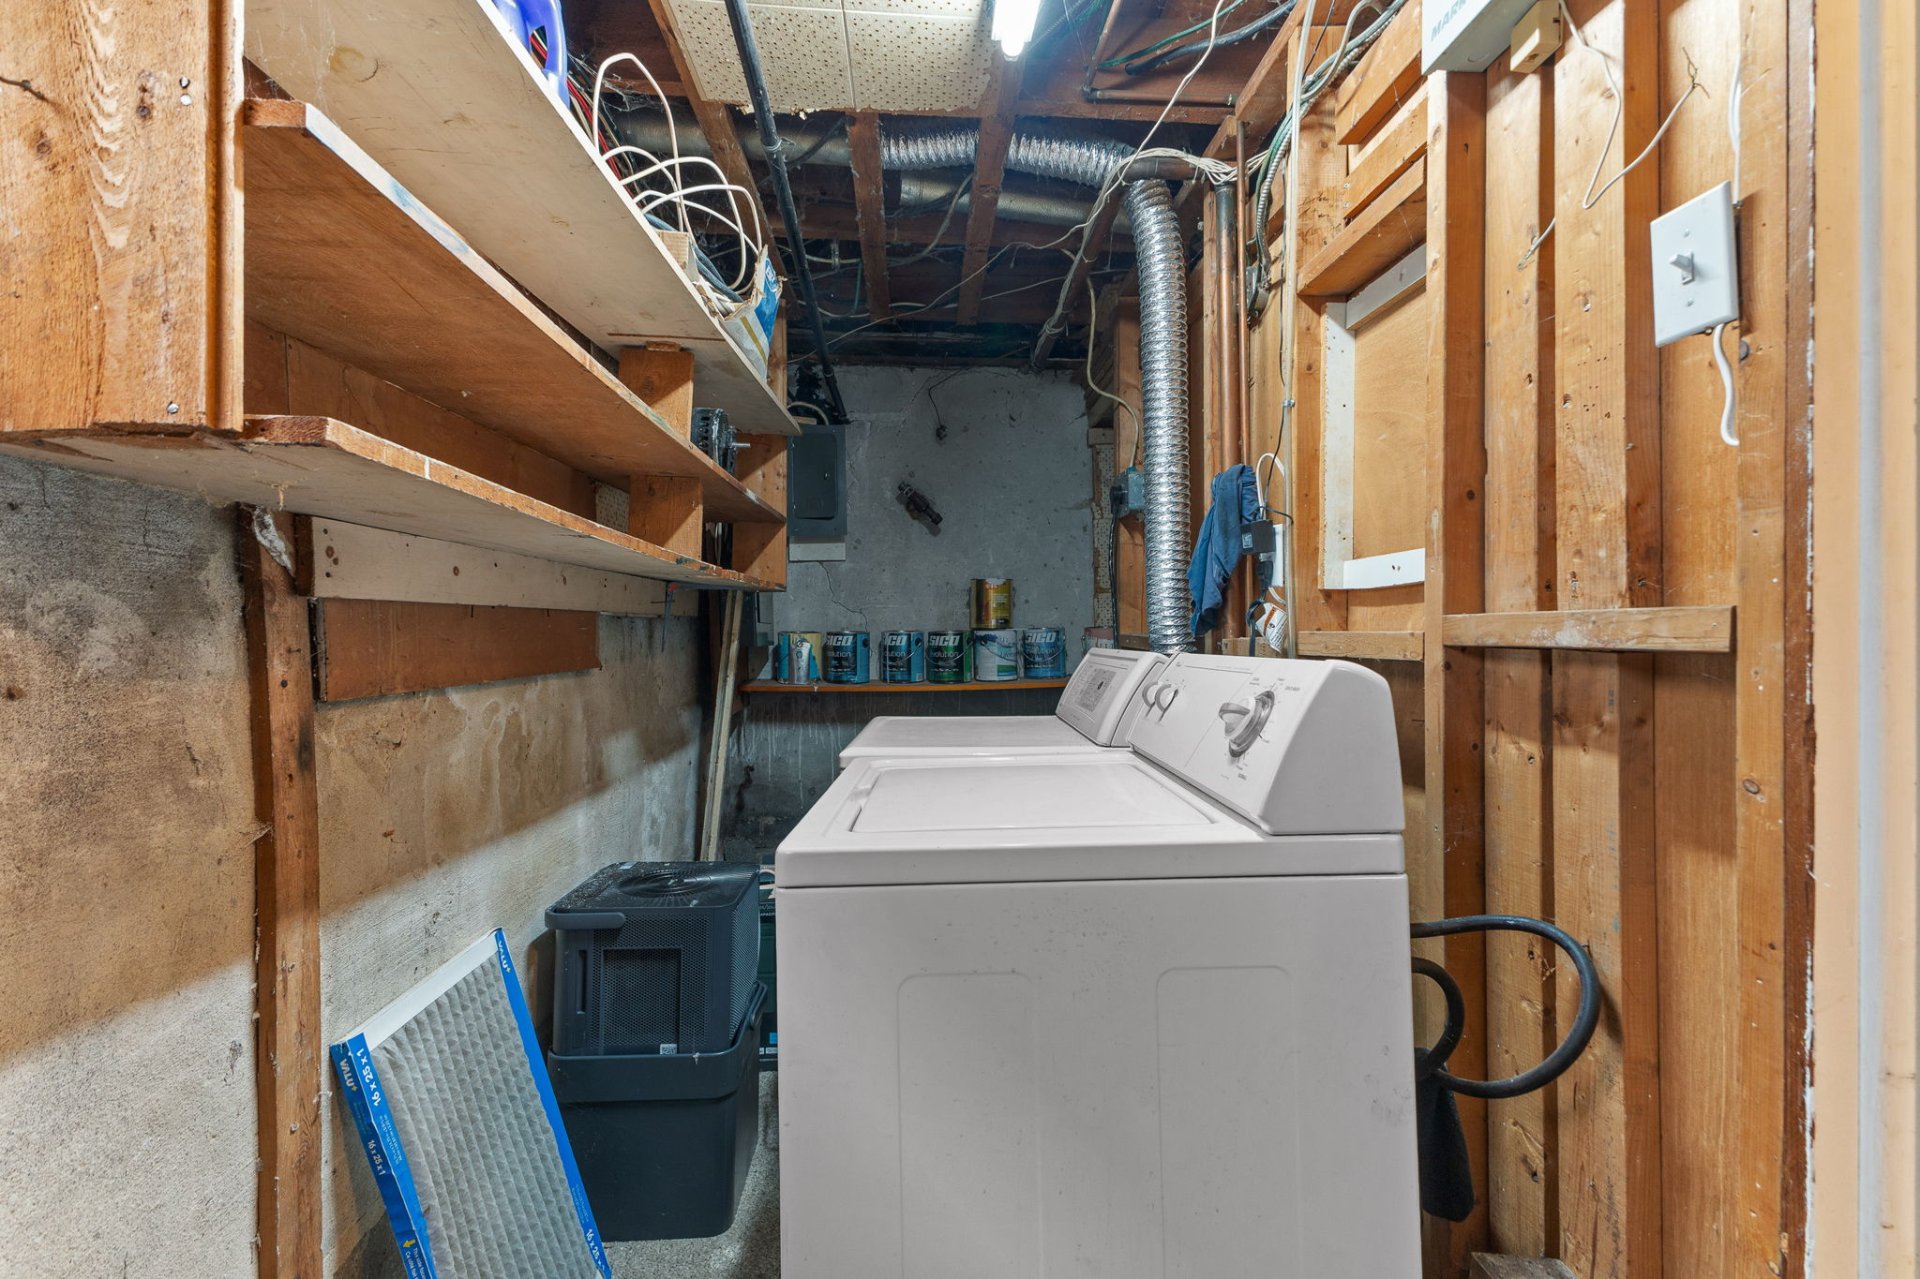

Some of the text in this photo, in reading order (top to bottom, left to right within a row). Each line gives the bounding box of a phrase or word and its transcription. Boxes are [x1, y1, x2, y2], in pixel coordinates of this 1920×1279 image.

[930, 635, 960, 646] SICO
[1025, 632, 1056, 643] SICO
[356, 1048, 364, 1057] 1
[363, 1066, 373, 1083] 25
[372, 1091, 381, 1106] 16
[367, 1139, 377, 1150] 16
[373, 1153, 383, 1167] 25
[587, 1229, 594, 1241] 16
[593, 1247, 599, 1260] 25
